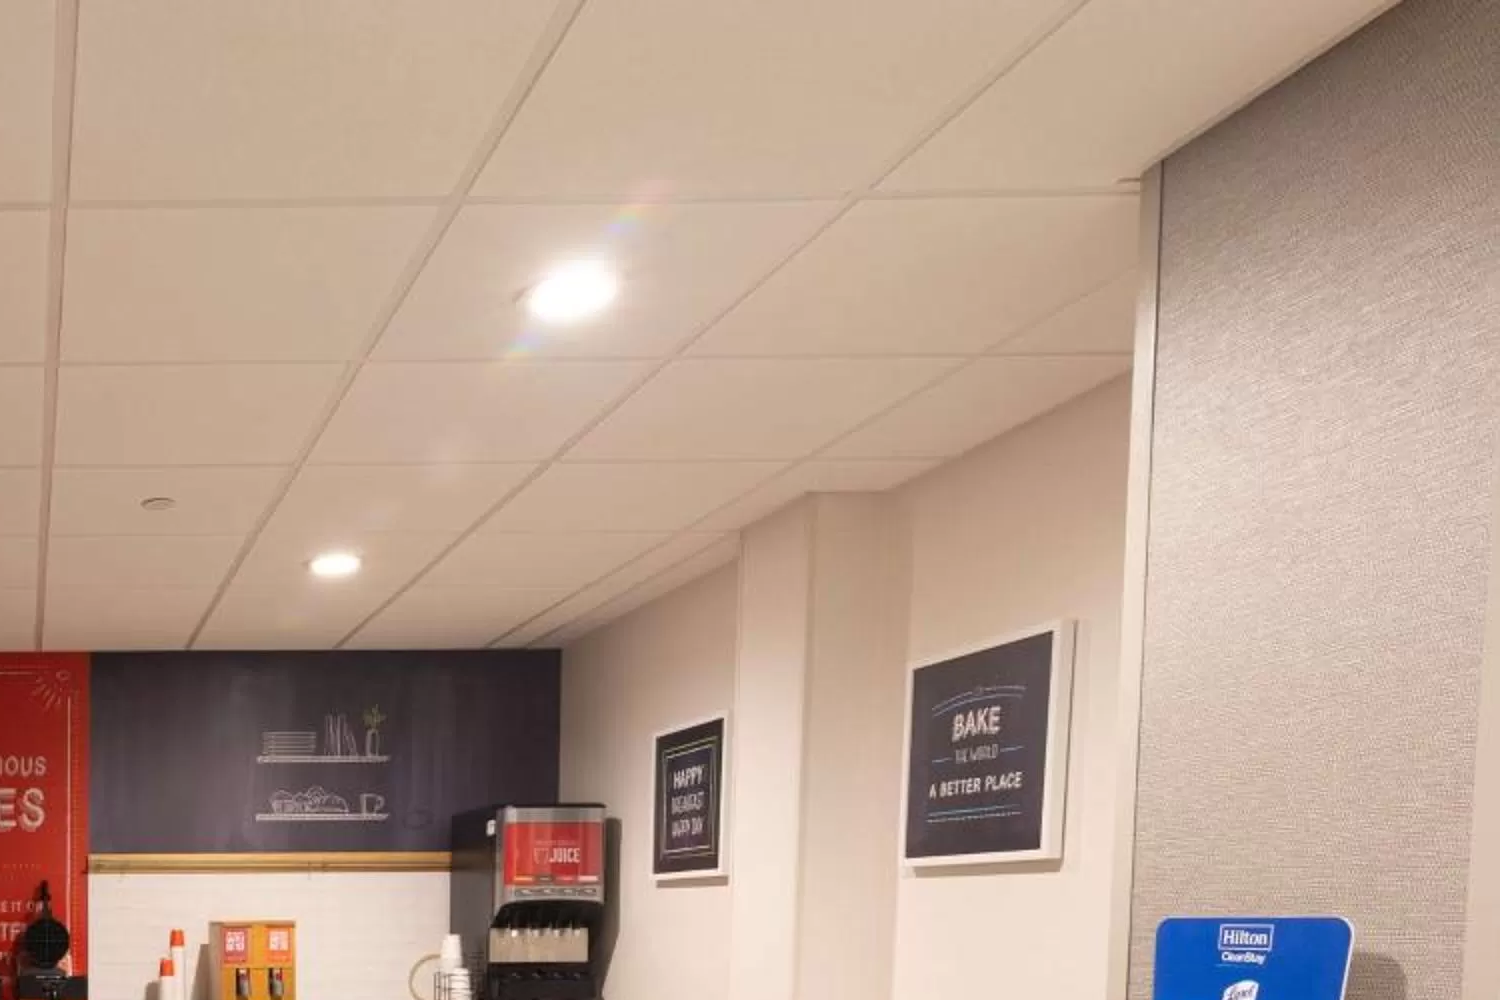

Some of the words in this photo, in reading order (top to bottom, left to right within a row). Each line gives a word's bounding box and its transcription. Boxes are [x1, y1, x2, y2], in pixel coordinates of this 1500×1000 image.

[951, 705, 1002, 742] BAKE
[929, 783, 937, 799] A
[939, 777, 981, 797] BETTER
[984, 771, 1023, 792] PLACE
[548, 847, 580, 863] JUICE
[1223, 929, 1268, 945] Hilton
